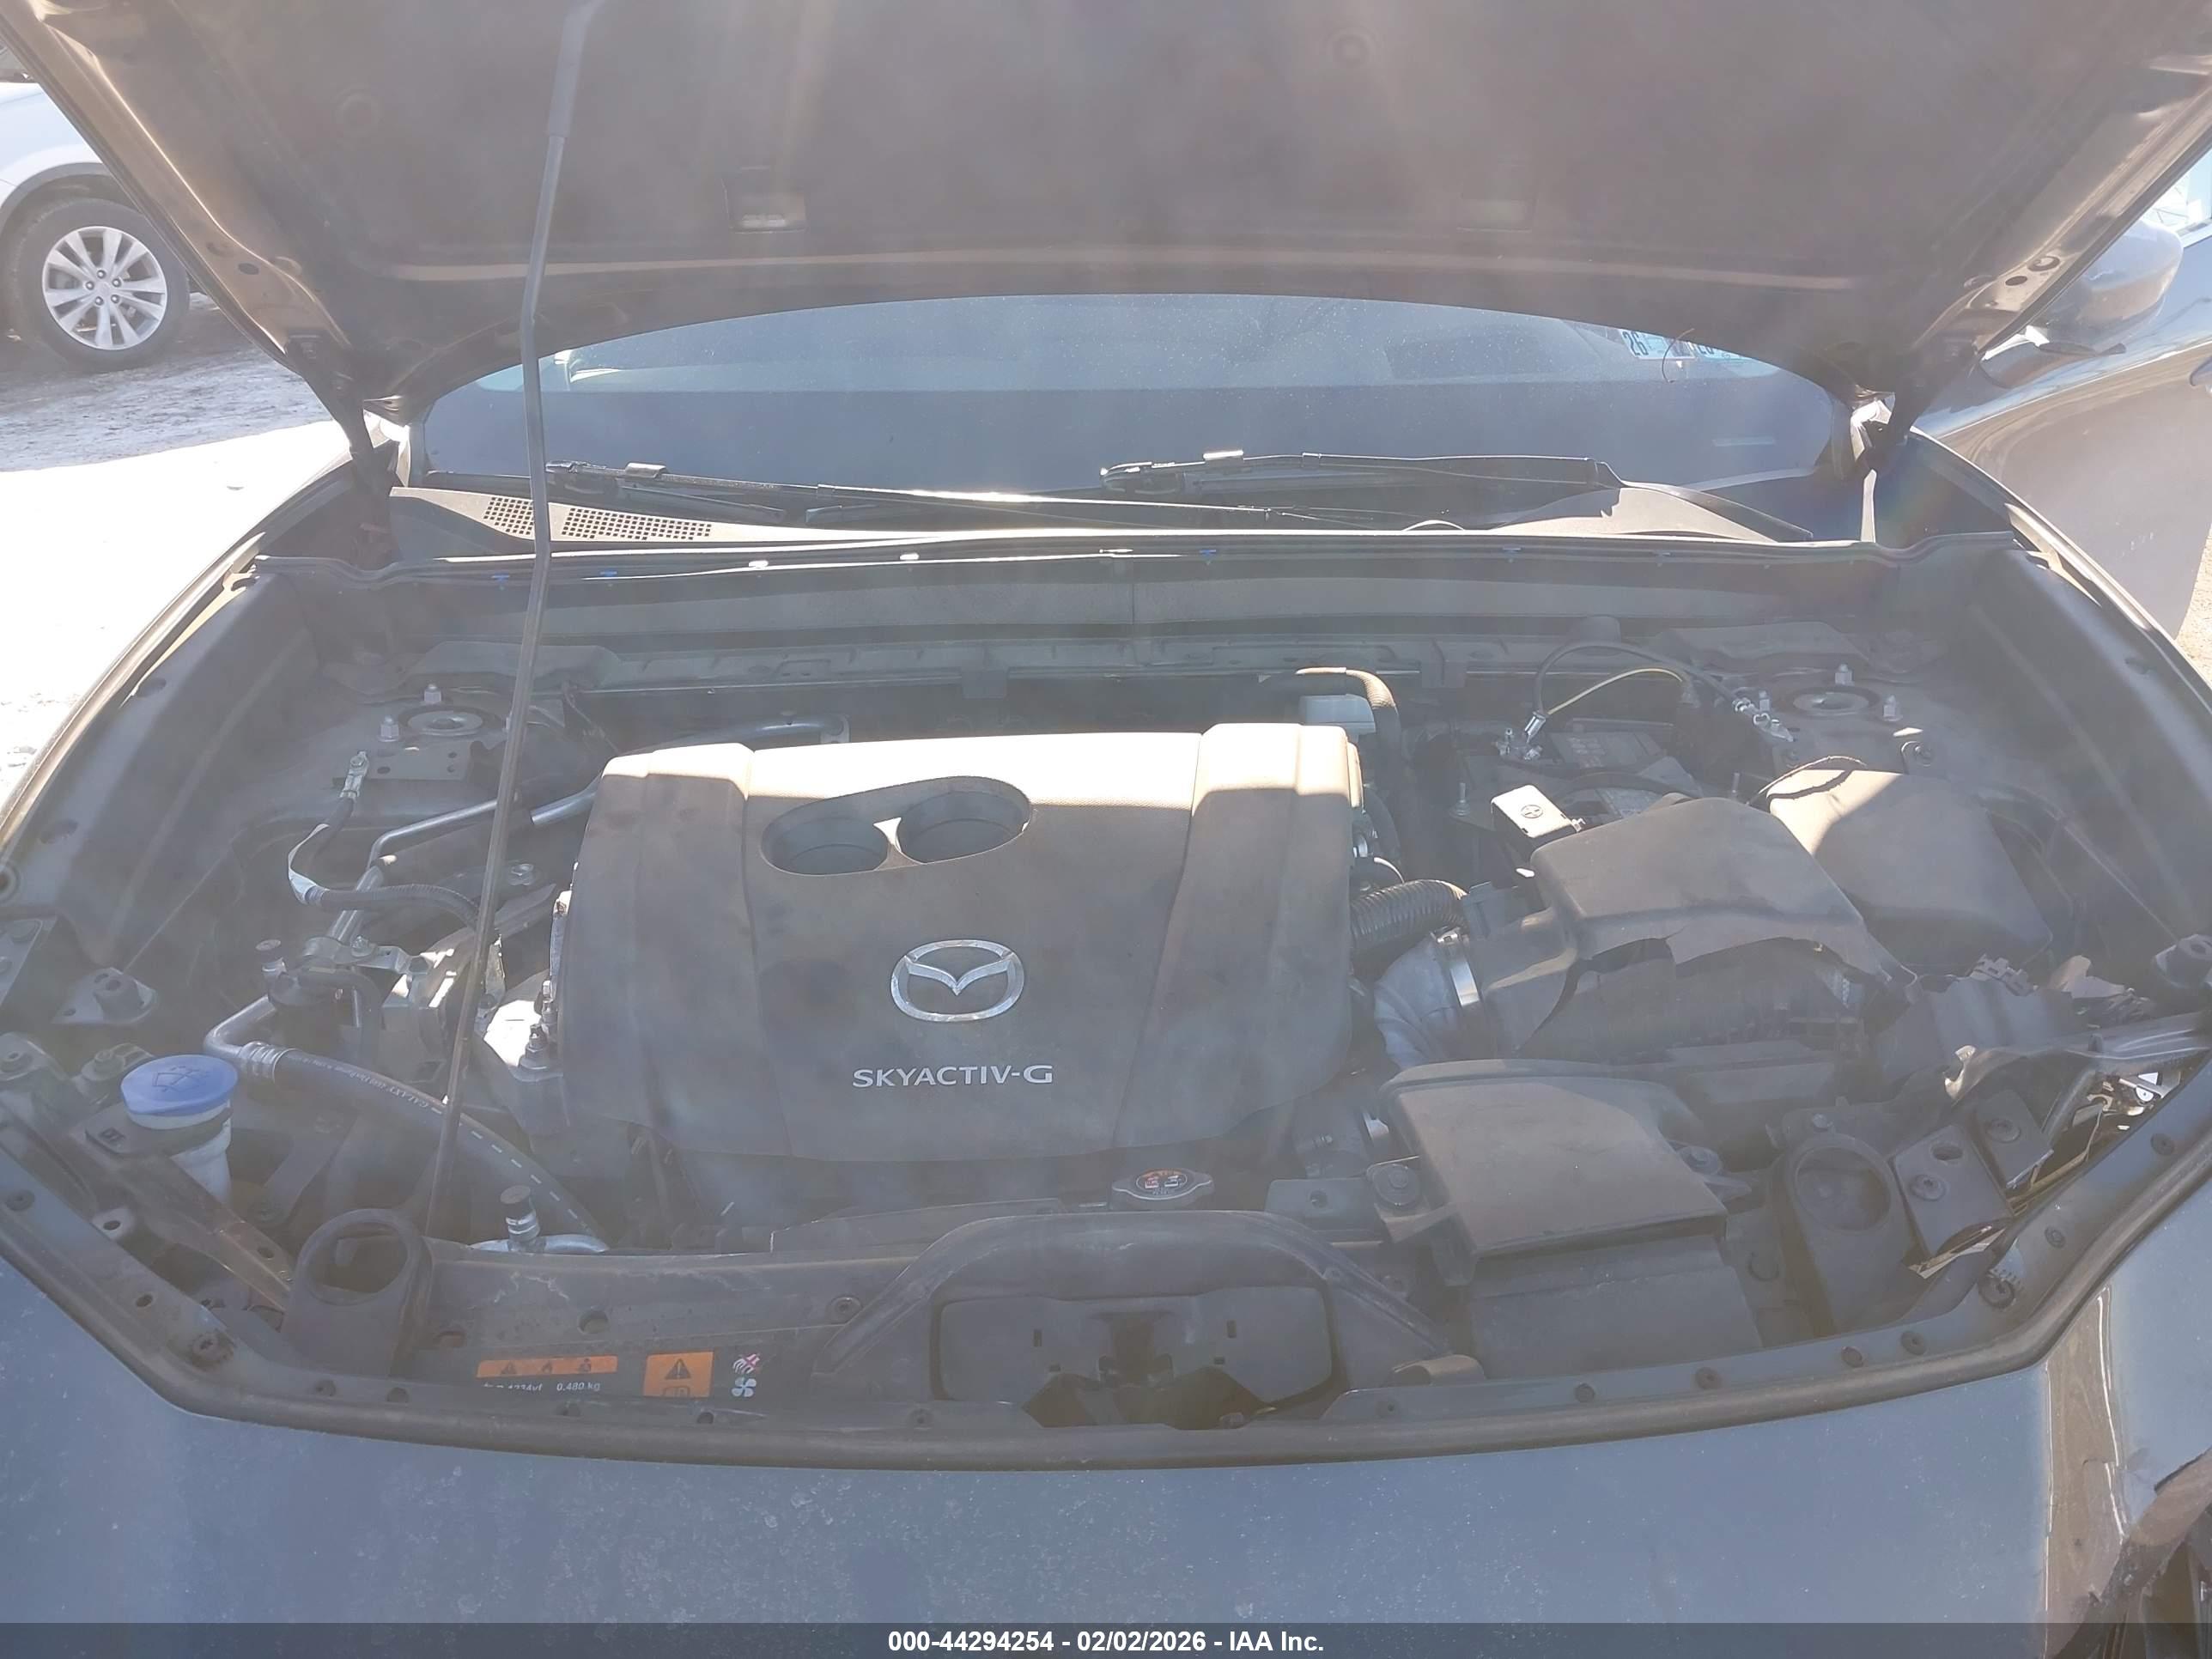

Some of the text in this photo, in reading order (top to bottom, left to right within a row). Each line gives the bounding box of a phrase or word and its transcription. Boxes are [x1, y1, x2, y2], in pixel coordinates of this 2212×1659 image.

[852, 1065, 1054, 1088] SKYACTIV-G
[556, 1381, 586, 1392] 0.480
[586, 1381, 601, 1392] kg
